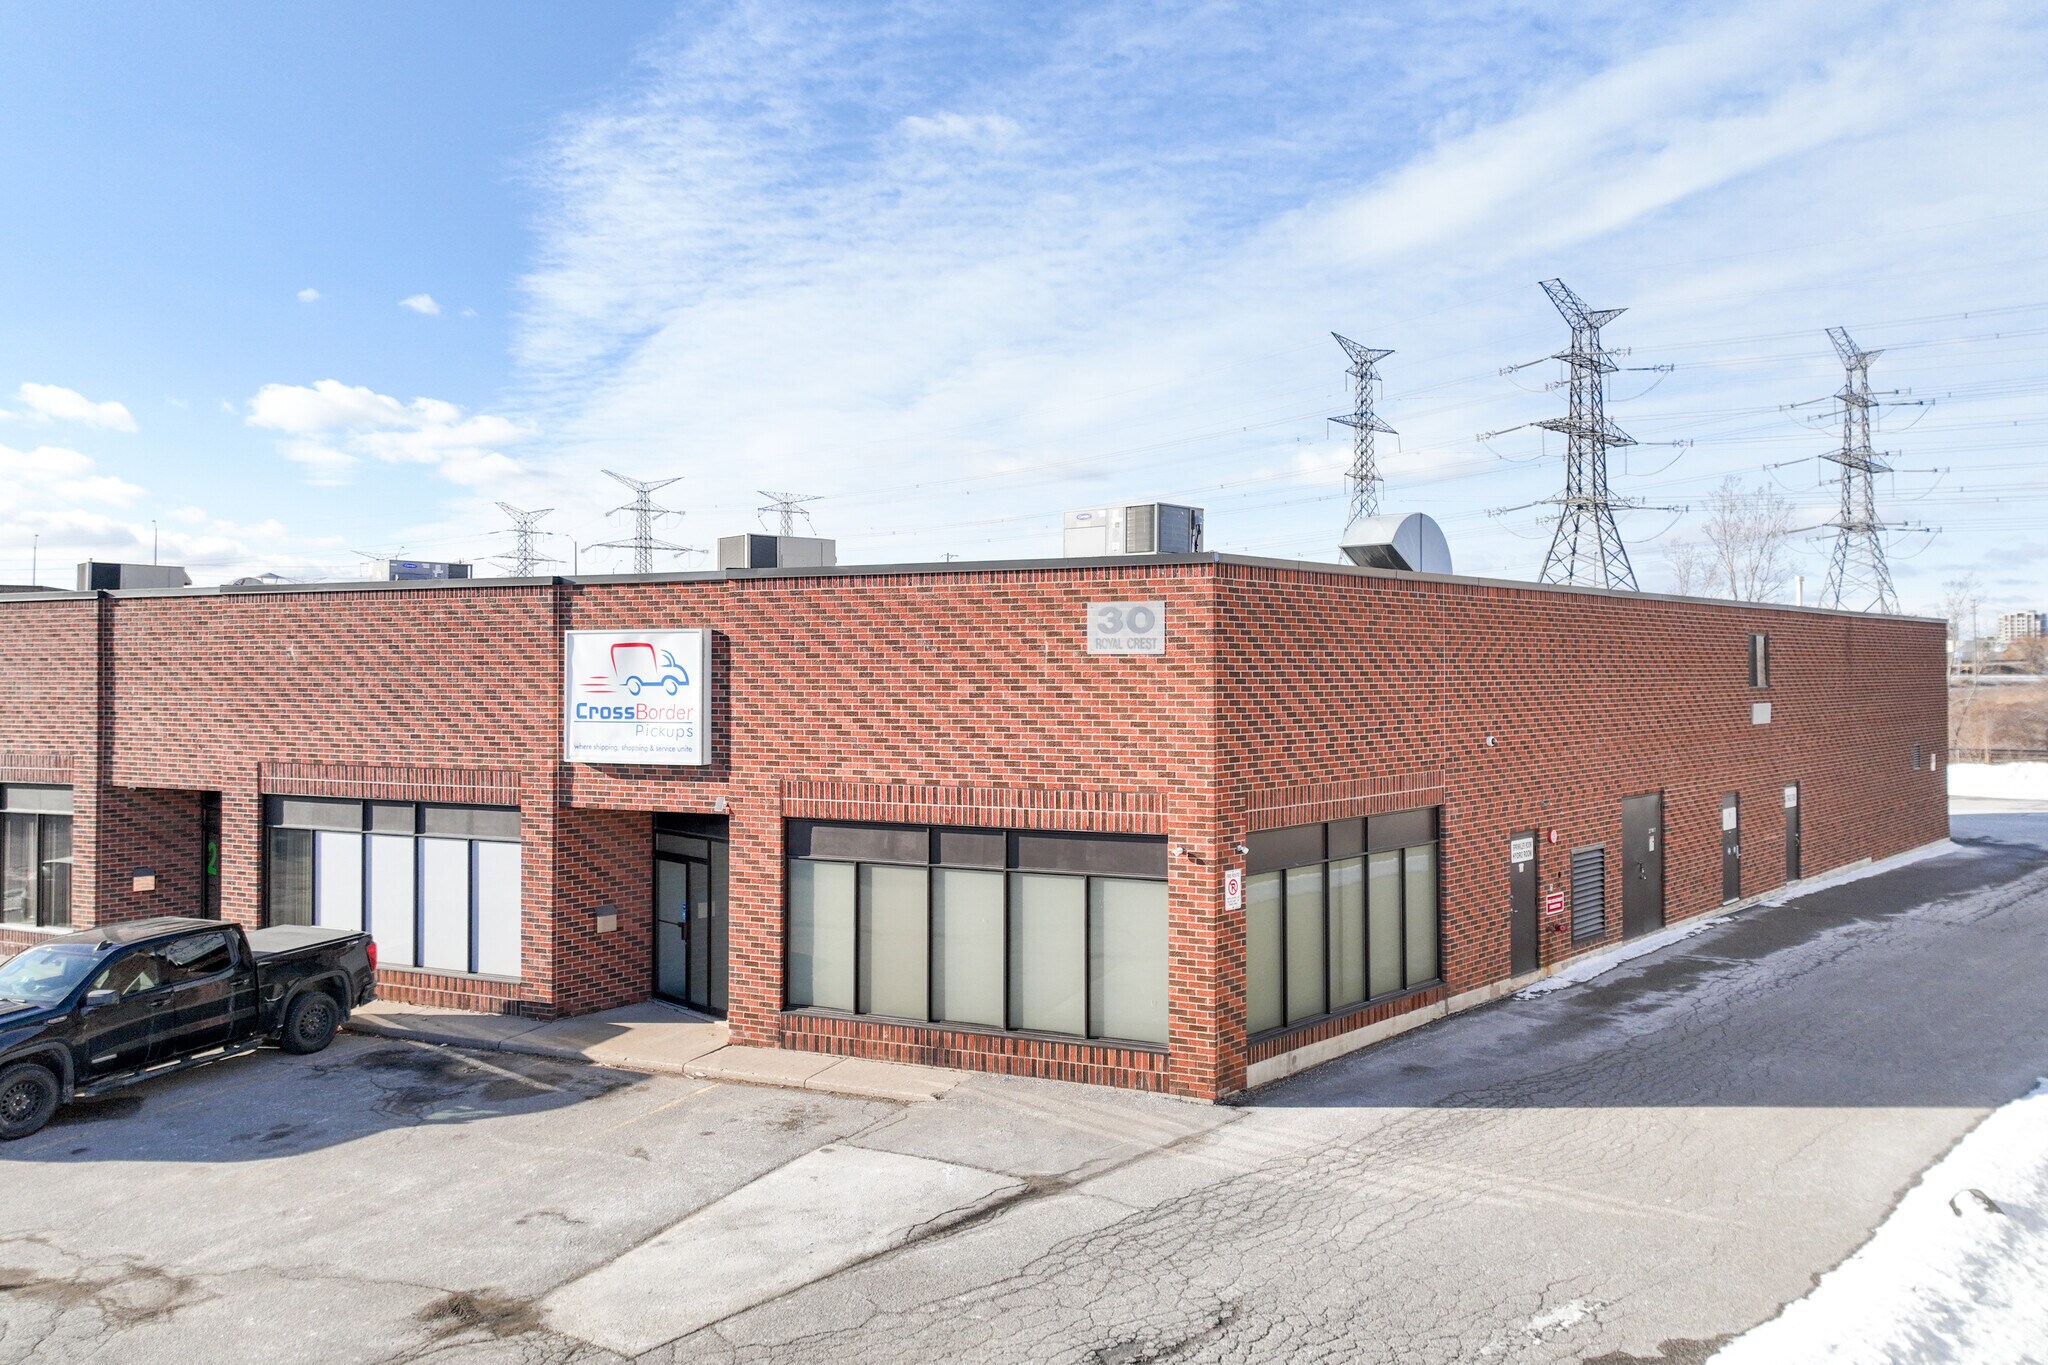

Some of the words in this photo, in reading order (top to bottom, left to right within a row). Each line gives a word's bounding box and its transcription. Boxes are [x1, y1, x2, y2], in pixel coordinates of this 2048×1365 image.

[1097, 606, 1155, 634] 30
[1096, 638, 1123, 650] ROYAL
[1127, 638, 1157, 650] CREST
[635, 724, 694, 741] Pickups
[593, 743, 619, 753] shipping,
[621, 744, 648, 753] shopping
[655, 745, 676, 753] service
[677, 745, 693, 753] unite
[208, 842, 216, 876] 2
